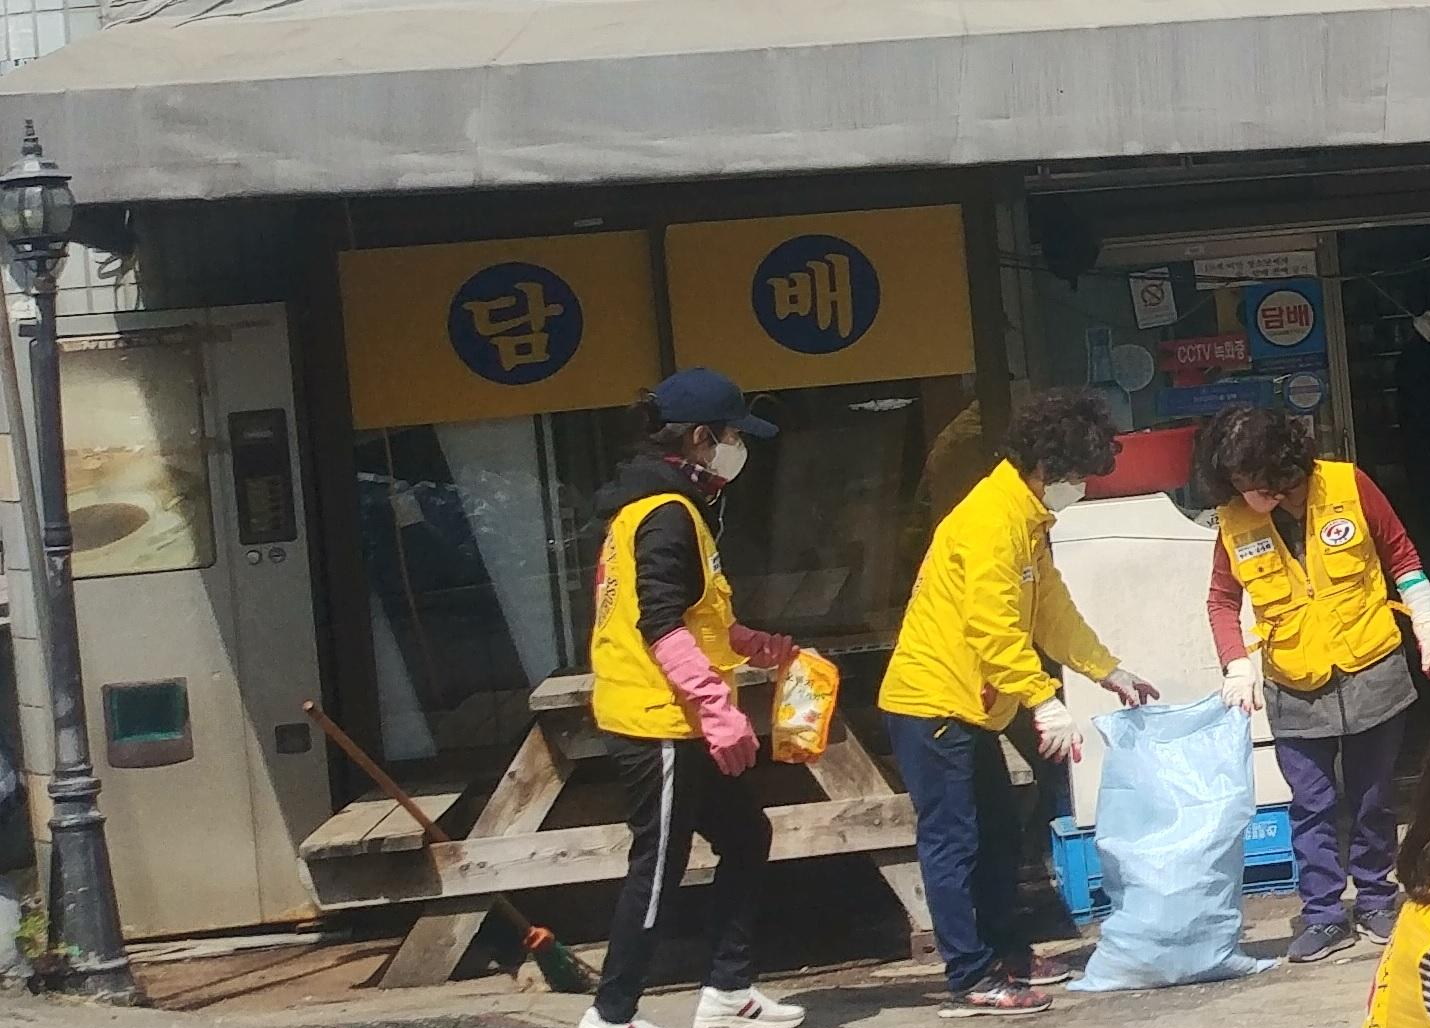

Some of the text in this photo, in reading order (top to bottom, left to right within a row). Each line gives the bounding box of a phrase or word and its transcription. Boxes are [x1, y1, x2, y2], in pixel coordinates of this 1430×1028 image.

[461, 252, 853, 373] 담 배
[1261, 303, 1310, 330] 담배
[1176, 339, 1246, 364] CCTV 녹화중
